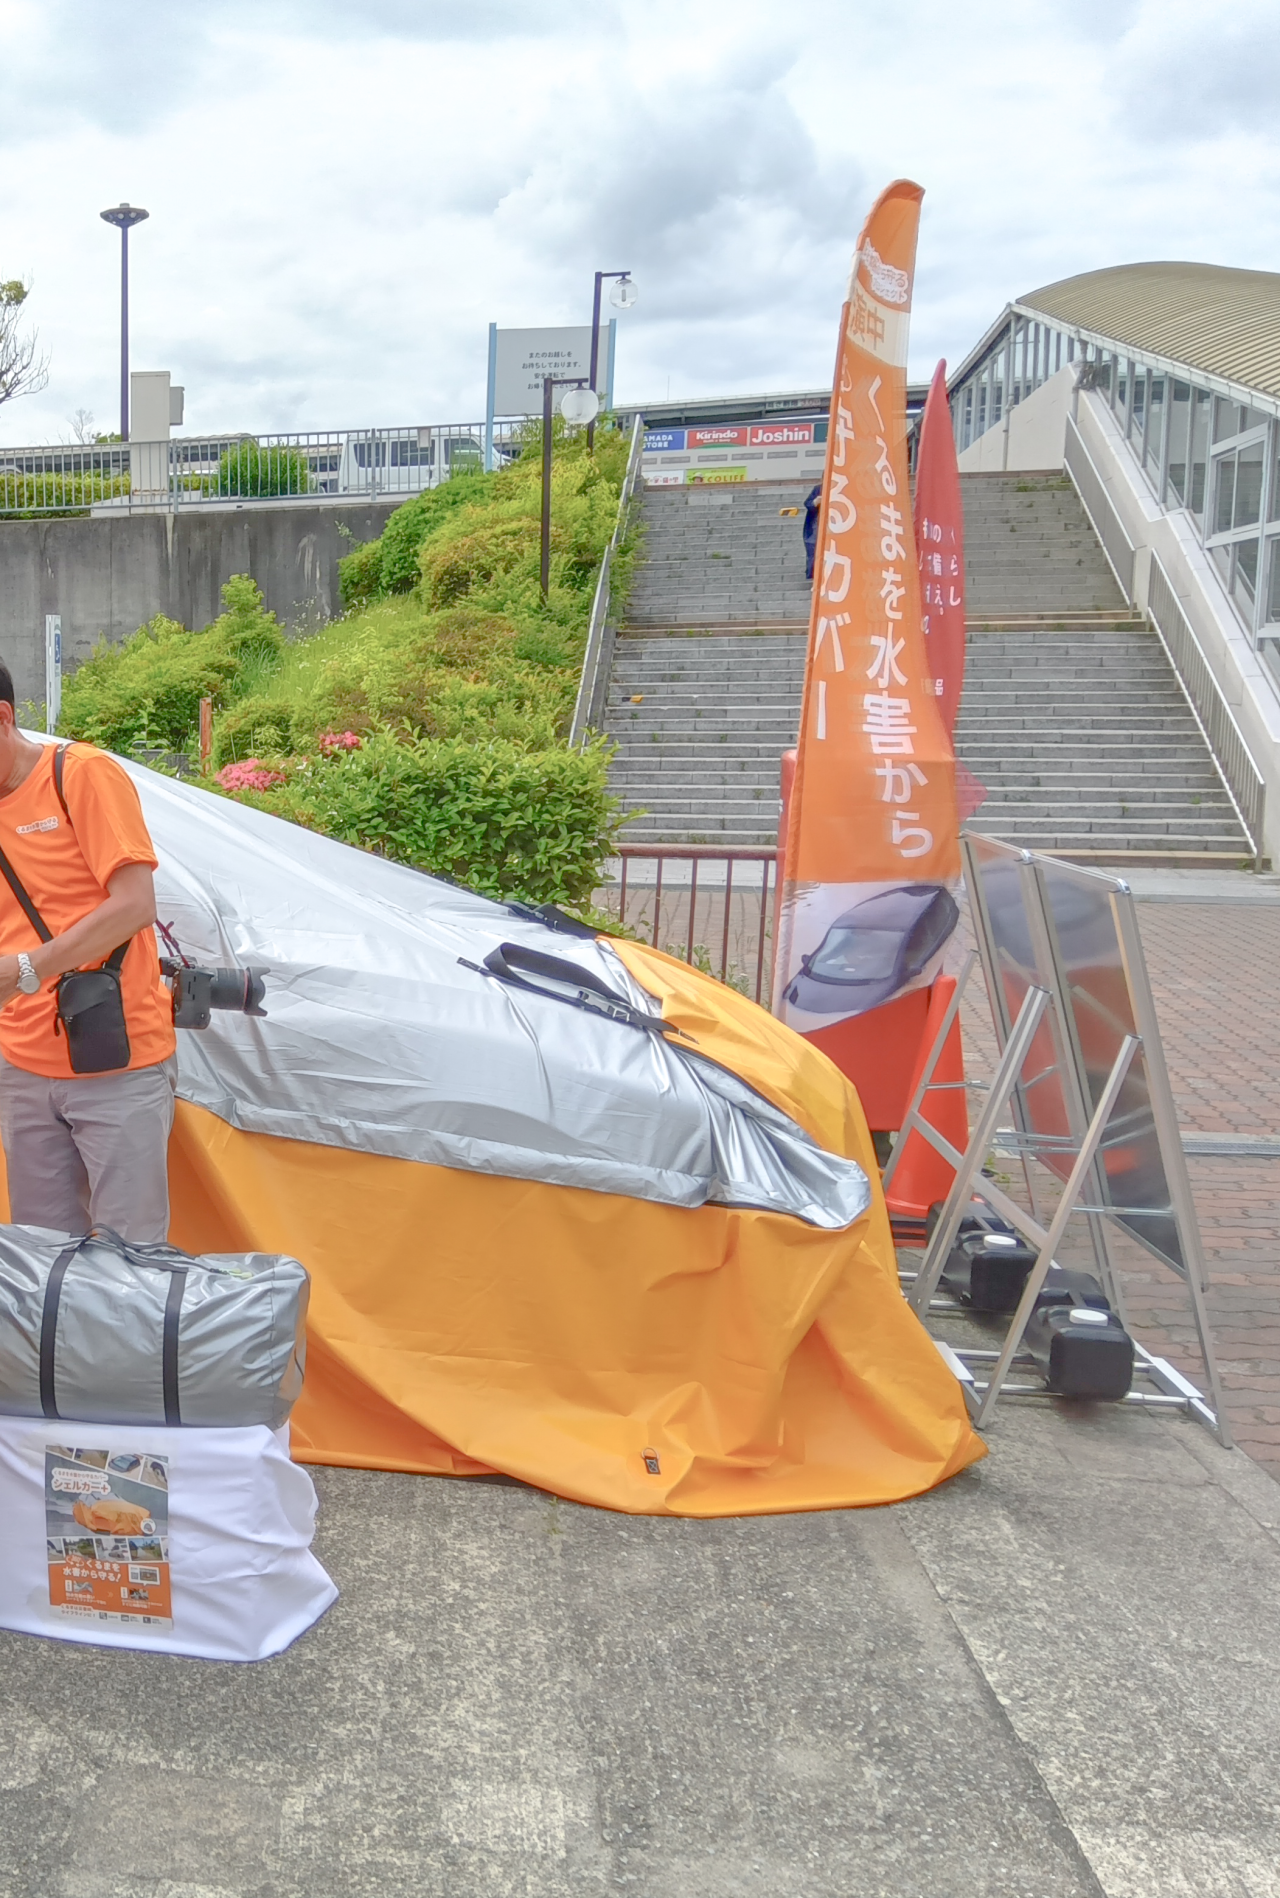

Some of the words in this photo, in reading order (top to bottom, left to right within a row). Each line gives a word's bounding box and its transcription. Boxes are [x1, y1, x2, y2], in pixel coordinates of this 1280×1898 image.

[528, 351, 573, 359] またのお越しを
[522, 361, 582, 369] お待ちしております。
[534, 371, 566, 379] 安全運転で
[696, 429, 738, 440] Kirindo
[751, 427, 810, 444] Joshin
[862, 374, 933, 858] くるまを水害から
[86, 1558, 121, 1573] くるまを
